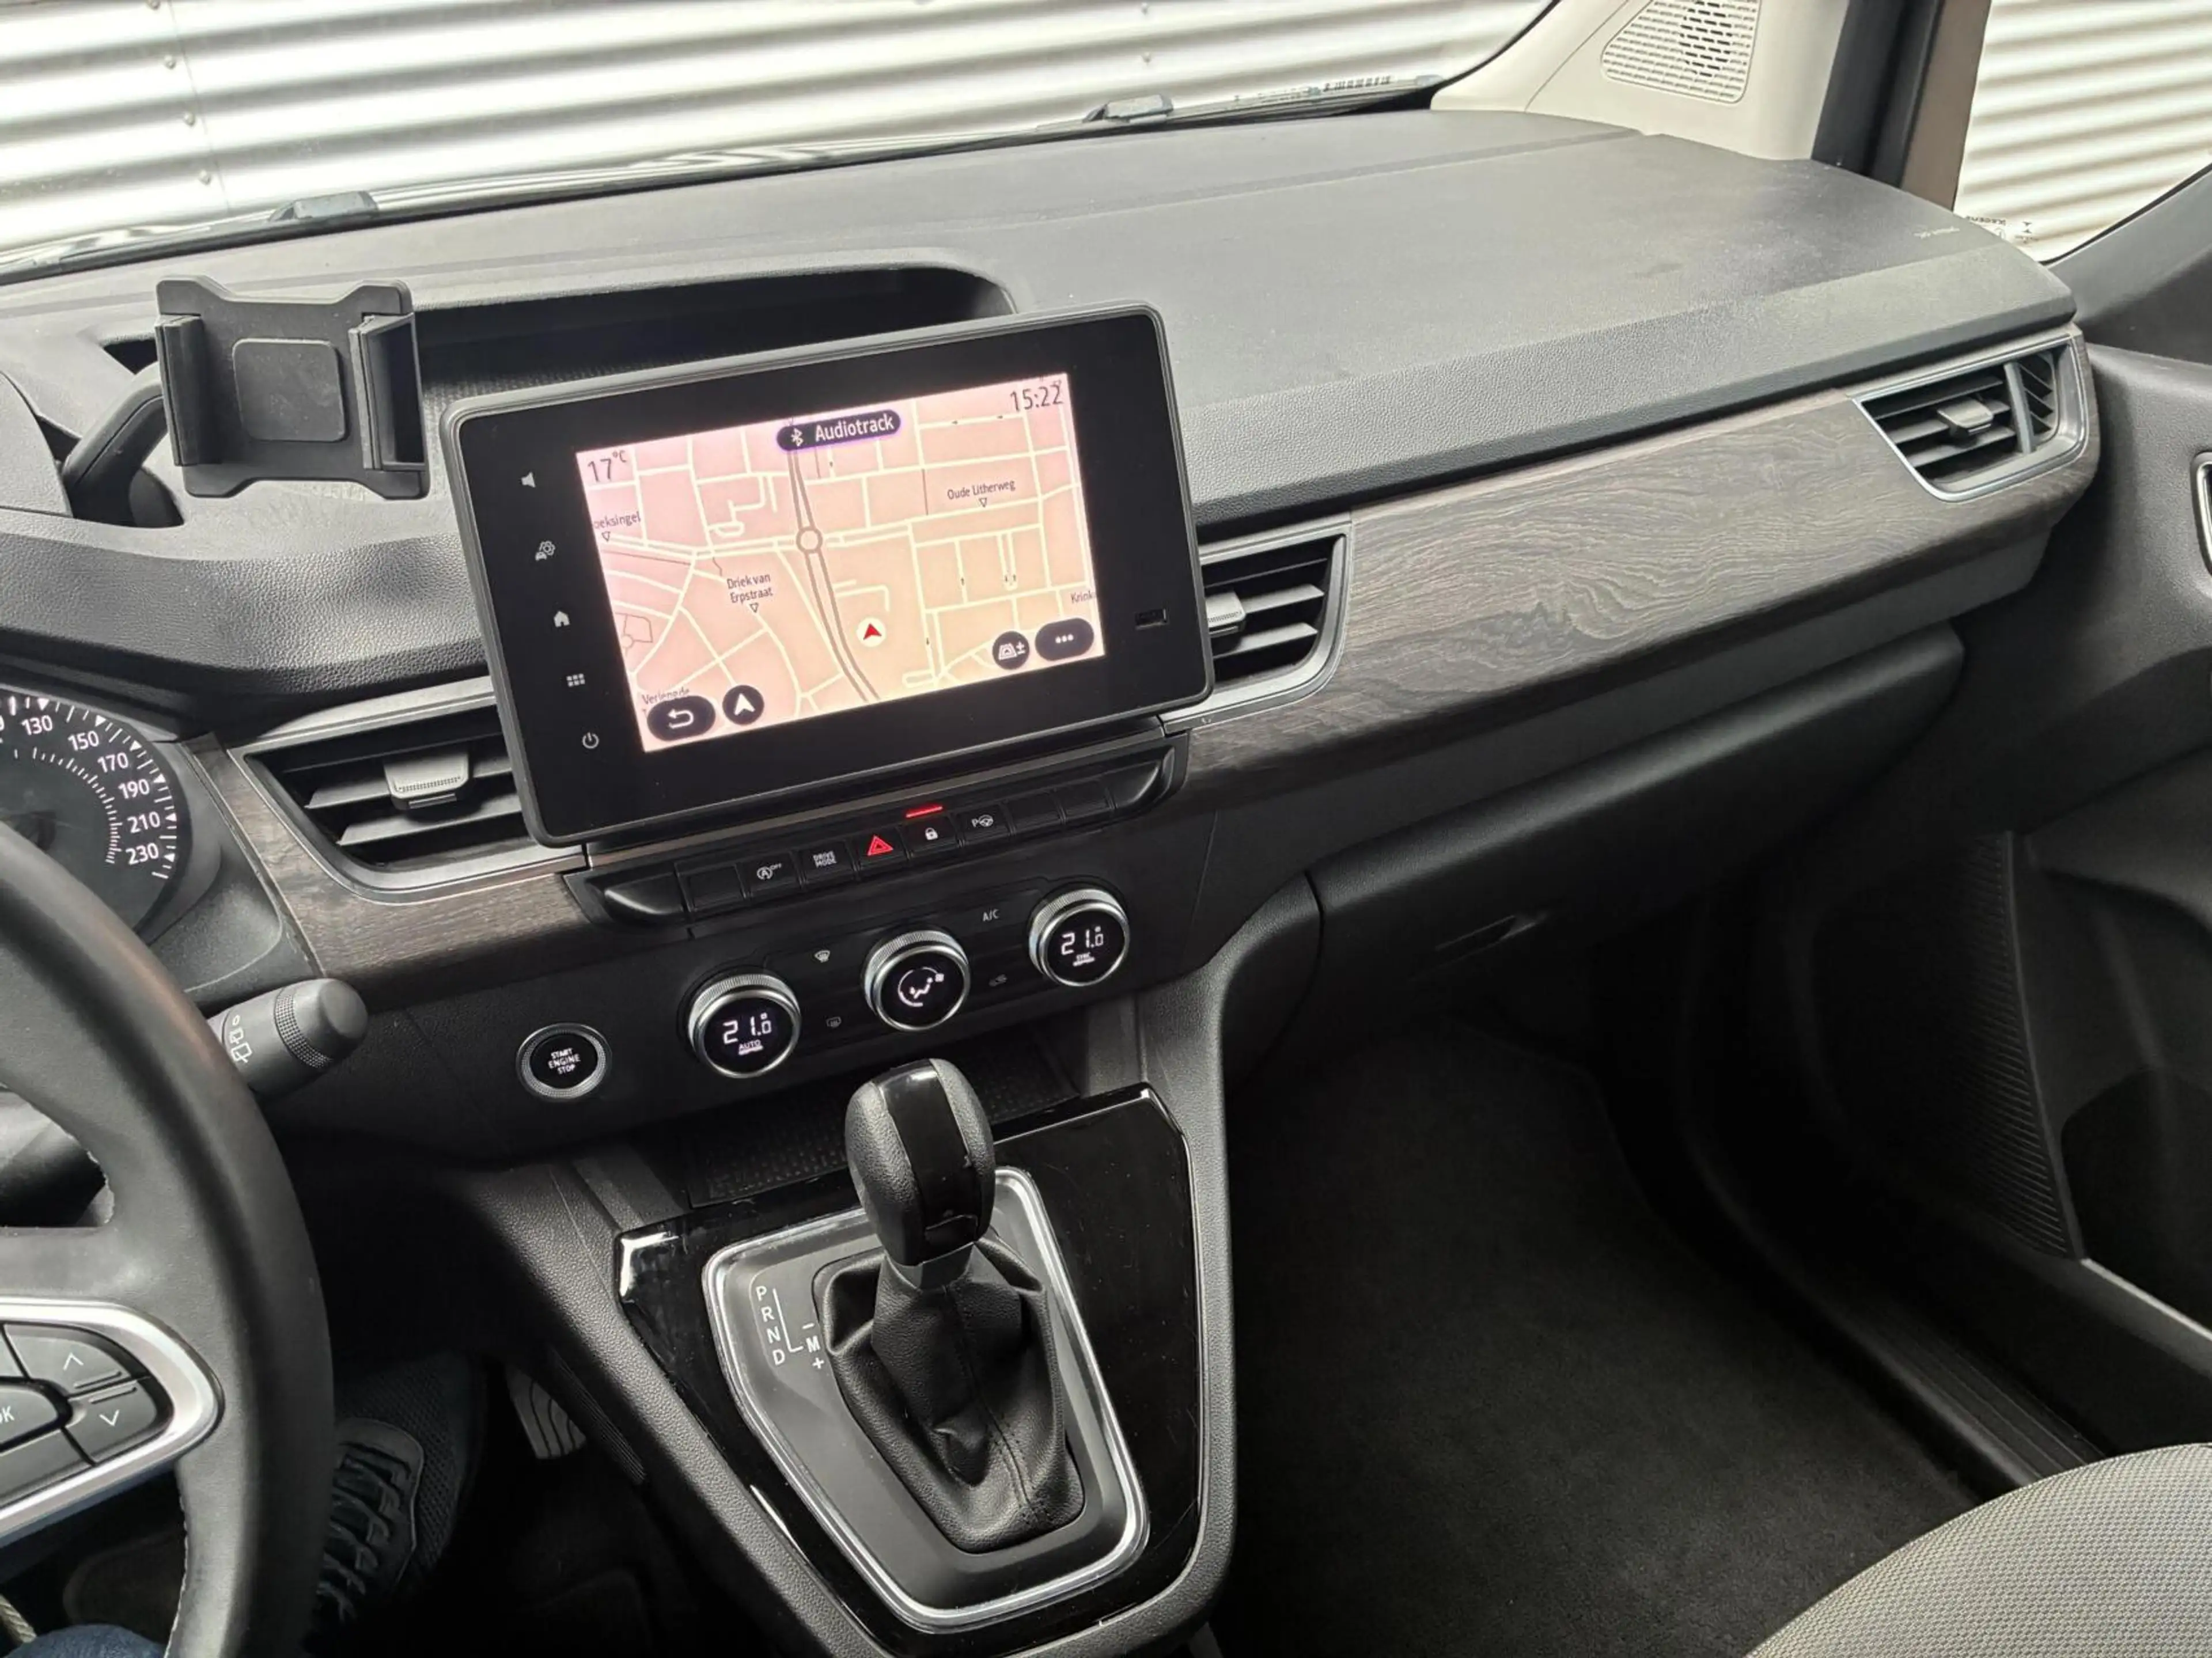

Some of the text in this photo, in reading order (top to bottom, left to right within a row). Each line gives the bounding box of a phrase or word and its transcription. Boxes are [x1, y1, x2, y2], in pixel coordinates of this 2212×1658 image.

[1010, 384, 1064, 412] 15:22
[815, 412, 895, 442] Audiotrack
[946, 487, 971, 500] Oude
[727, 574, 771, 589] Driek van
[730, 587, 773, 605] Erpstraat
[21, 715, 53, 735] 130
[68, 730, 100, 752] 150
[97, 752, 129, 773] 170
[118, 779, 150, 799] 190
[127, 811, 160, 833] 210
[126, 843, 159, 865] 230
[983, 909, 1000, 921] A/C
[551, 1048, 573, 1059] START
[739, 1039, 761, 1052] AUTO
[548, 1054, 581, 1069] ENGINE
[558, 1064, 575, 1074] STOP
[756, 1285, 767, 1301] P
[761, 1306, 775, 1322] R
[767, 1326, 781, 1344] N
[806, 1335, 820, 1353] M
[772, 1349, 786, 1365] D
